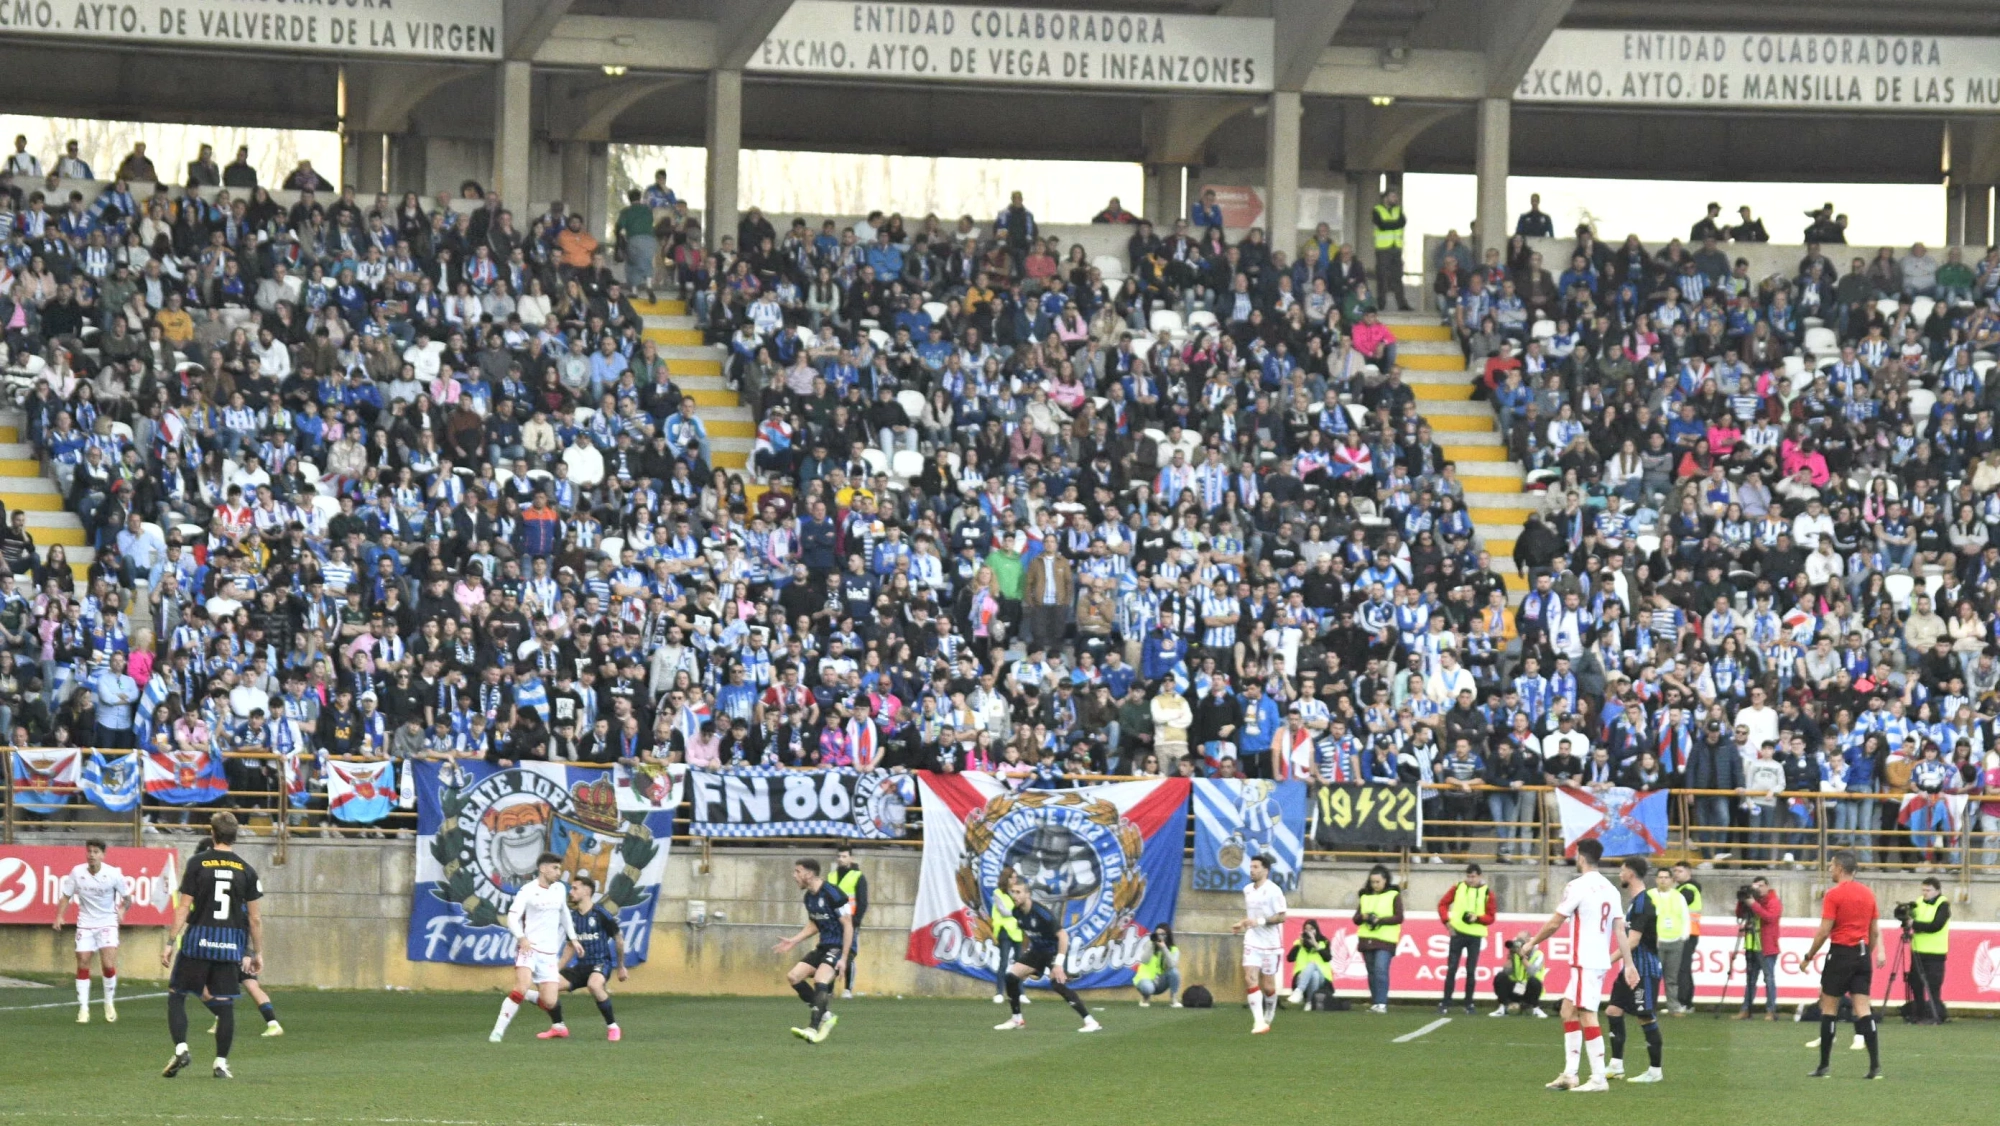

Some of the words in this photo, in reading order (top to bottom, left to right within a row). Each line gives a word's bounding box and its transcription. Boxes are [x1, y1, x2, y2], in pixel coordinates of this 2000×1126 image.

[74, 2, 146, 33] AYTO.
[159, 7, 187, 35] DE
[198, 9, 317, 44] VALVERDE
[330, 17, 357, 45] DE
[369, 19, 396, 47] LA
[406, 21, 495, 53] VIRGEN
[854, 4, 955, 35] ENTIDAD
[972, 10, 1165, 43] COLABORADORA
[762, 38, 855, 69] EXCMO.
[866, 43, 937, 72] AYTO.
[951, 47, 976, 74] DE
[989, 49, 1050, 77] VEGA
[1063, 51, 1089, 78] DE
[1102, 55, 1255, 85] INFANZONES
[1624, 34, 1726, 62] ENTIDAD
[1743, 36, 1941, 66] COLABORADORA
[1622, 71, 1691, 99] AYTO.
[1703, 74, 1729, 99] DE
[1743, 74, 1862, 102] MANSILLA
[1876, 77, 1901, 102] DE
[1914, 77, 1954, 103] LAS
[520, 770, 580, 820] NORT
[691, 771, 771, 823] FN
[783, 772, 850, 820] 86
[1062, 810, 1106, 843] 1922
[213, 880, 231, 920] 5
[1600, 901, 1612, 933] 8
